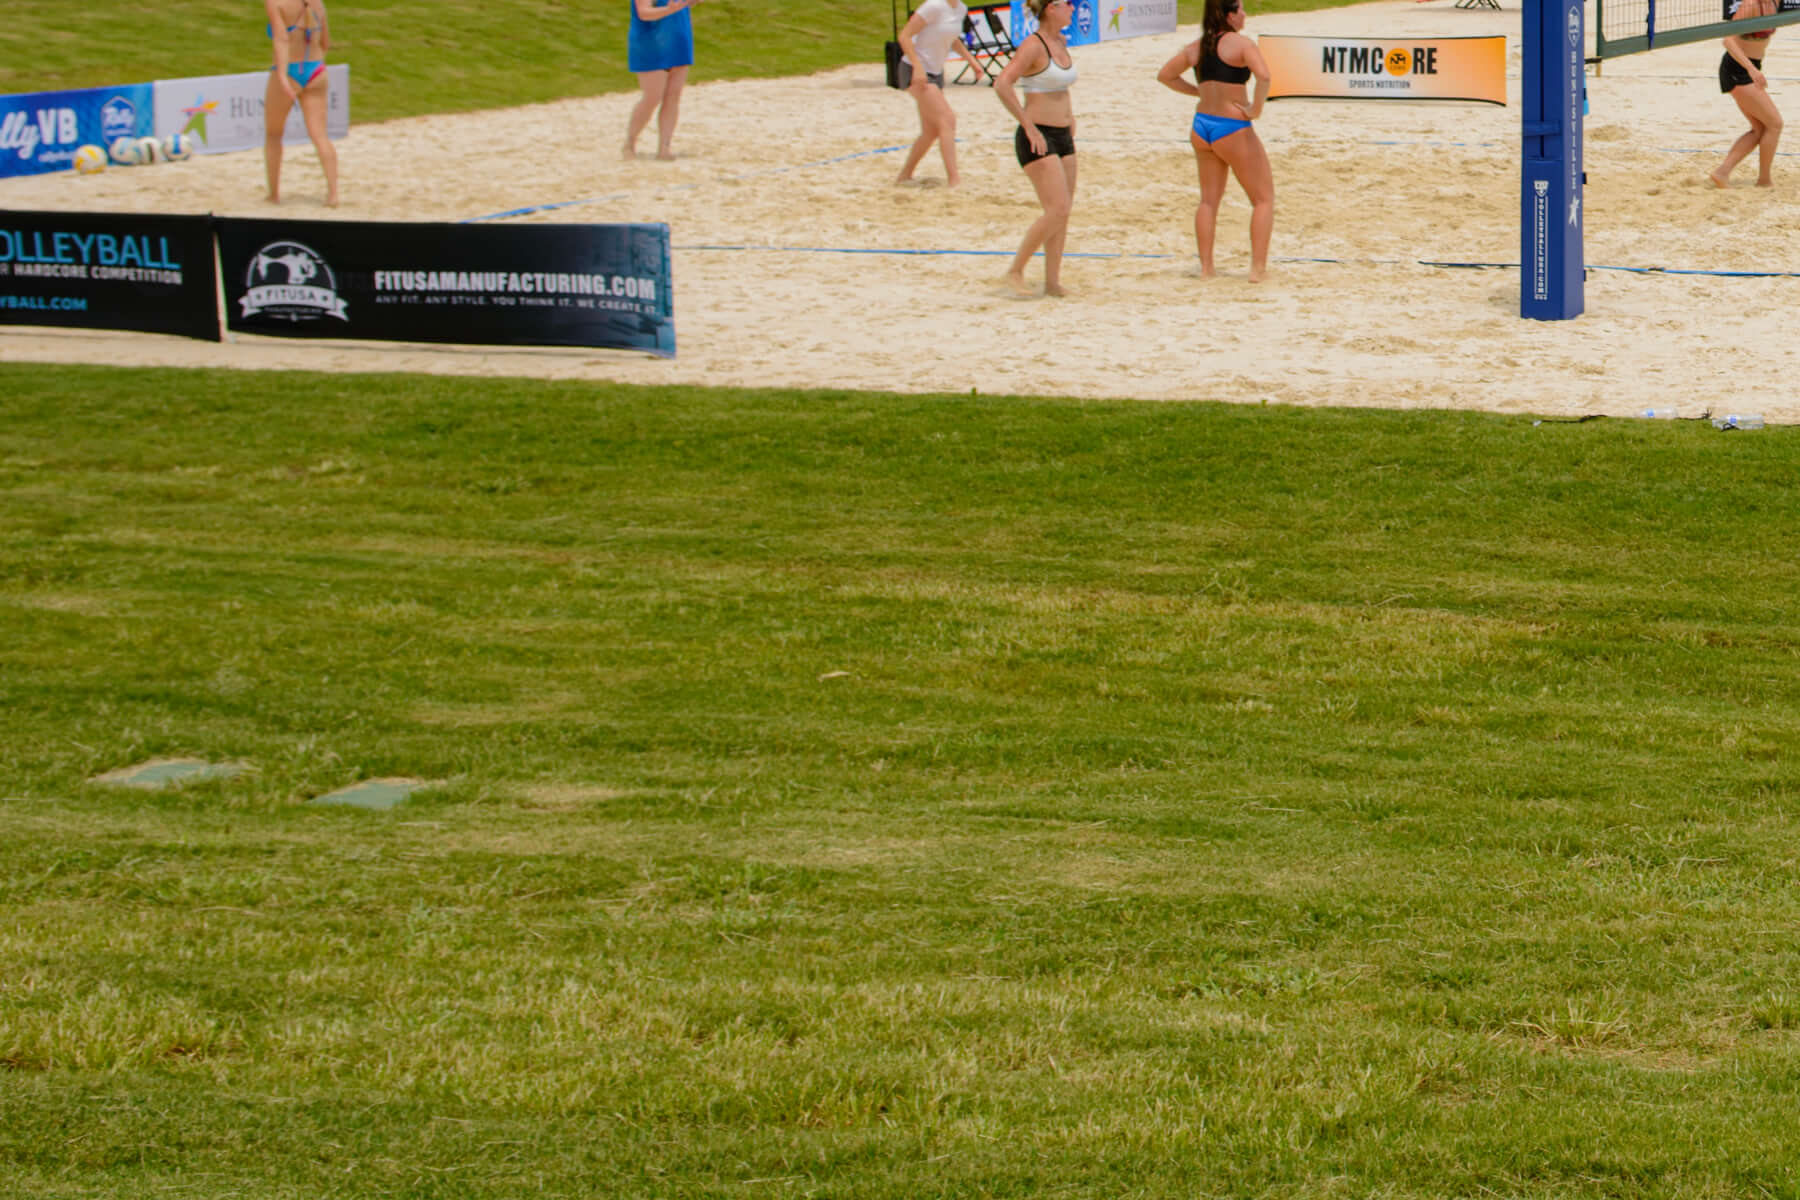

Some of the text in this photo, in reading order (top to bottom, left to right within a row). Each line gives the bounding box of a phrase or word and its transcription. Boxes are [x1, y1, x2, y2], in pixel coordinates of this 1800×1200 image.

[0, 108, 78, 160] llyVB
[14, 263, 88, 278] HARDCORE
[91, 266, 183, 285] COMPETITION
[374, 270, 657, 300] FITUSAMANUFACTURING.COM
[493, 296, 516, 307] YOU
[520, 296, 555, 307] THINK
[578, 298, 595, 310] WE
